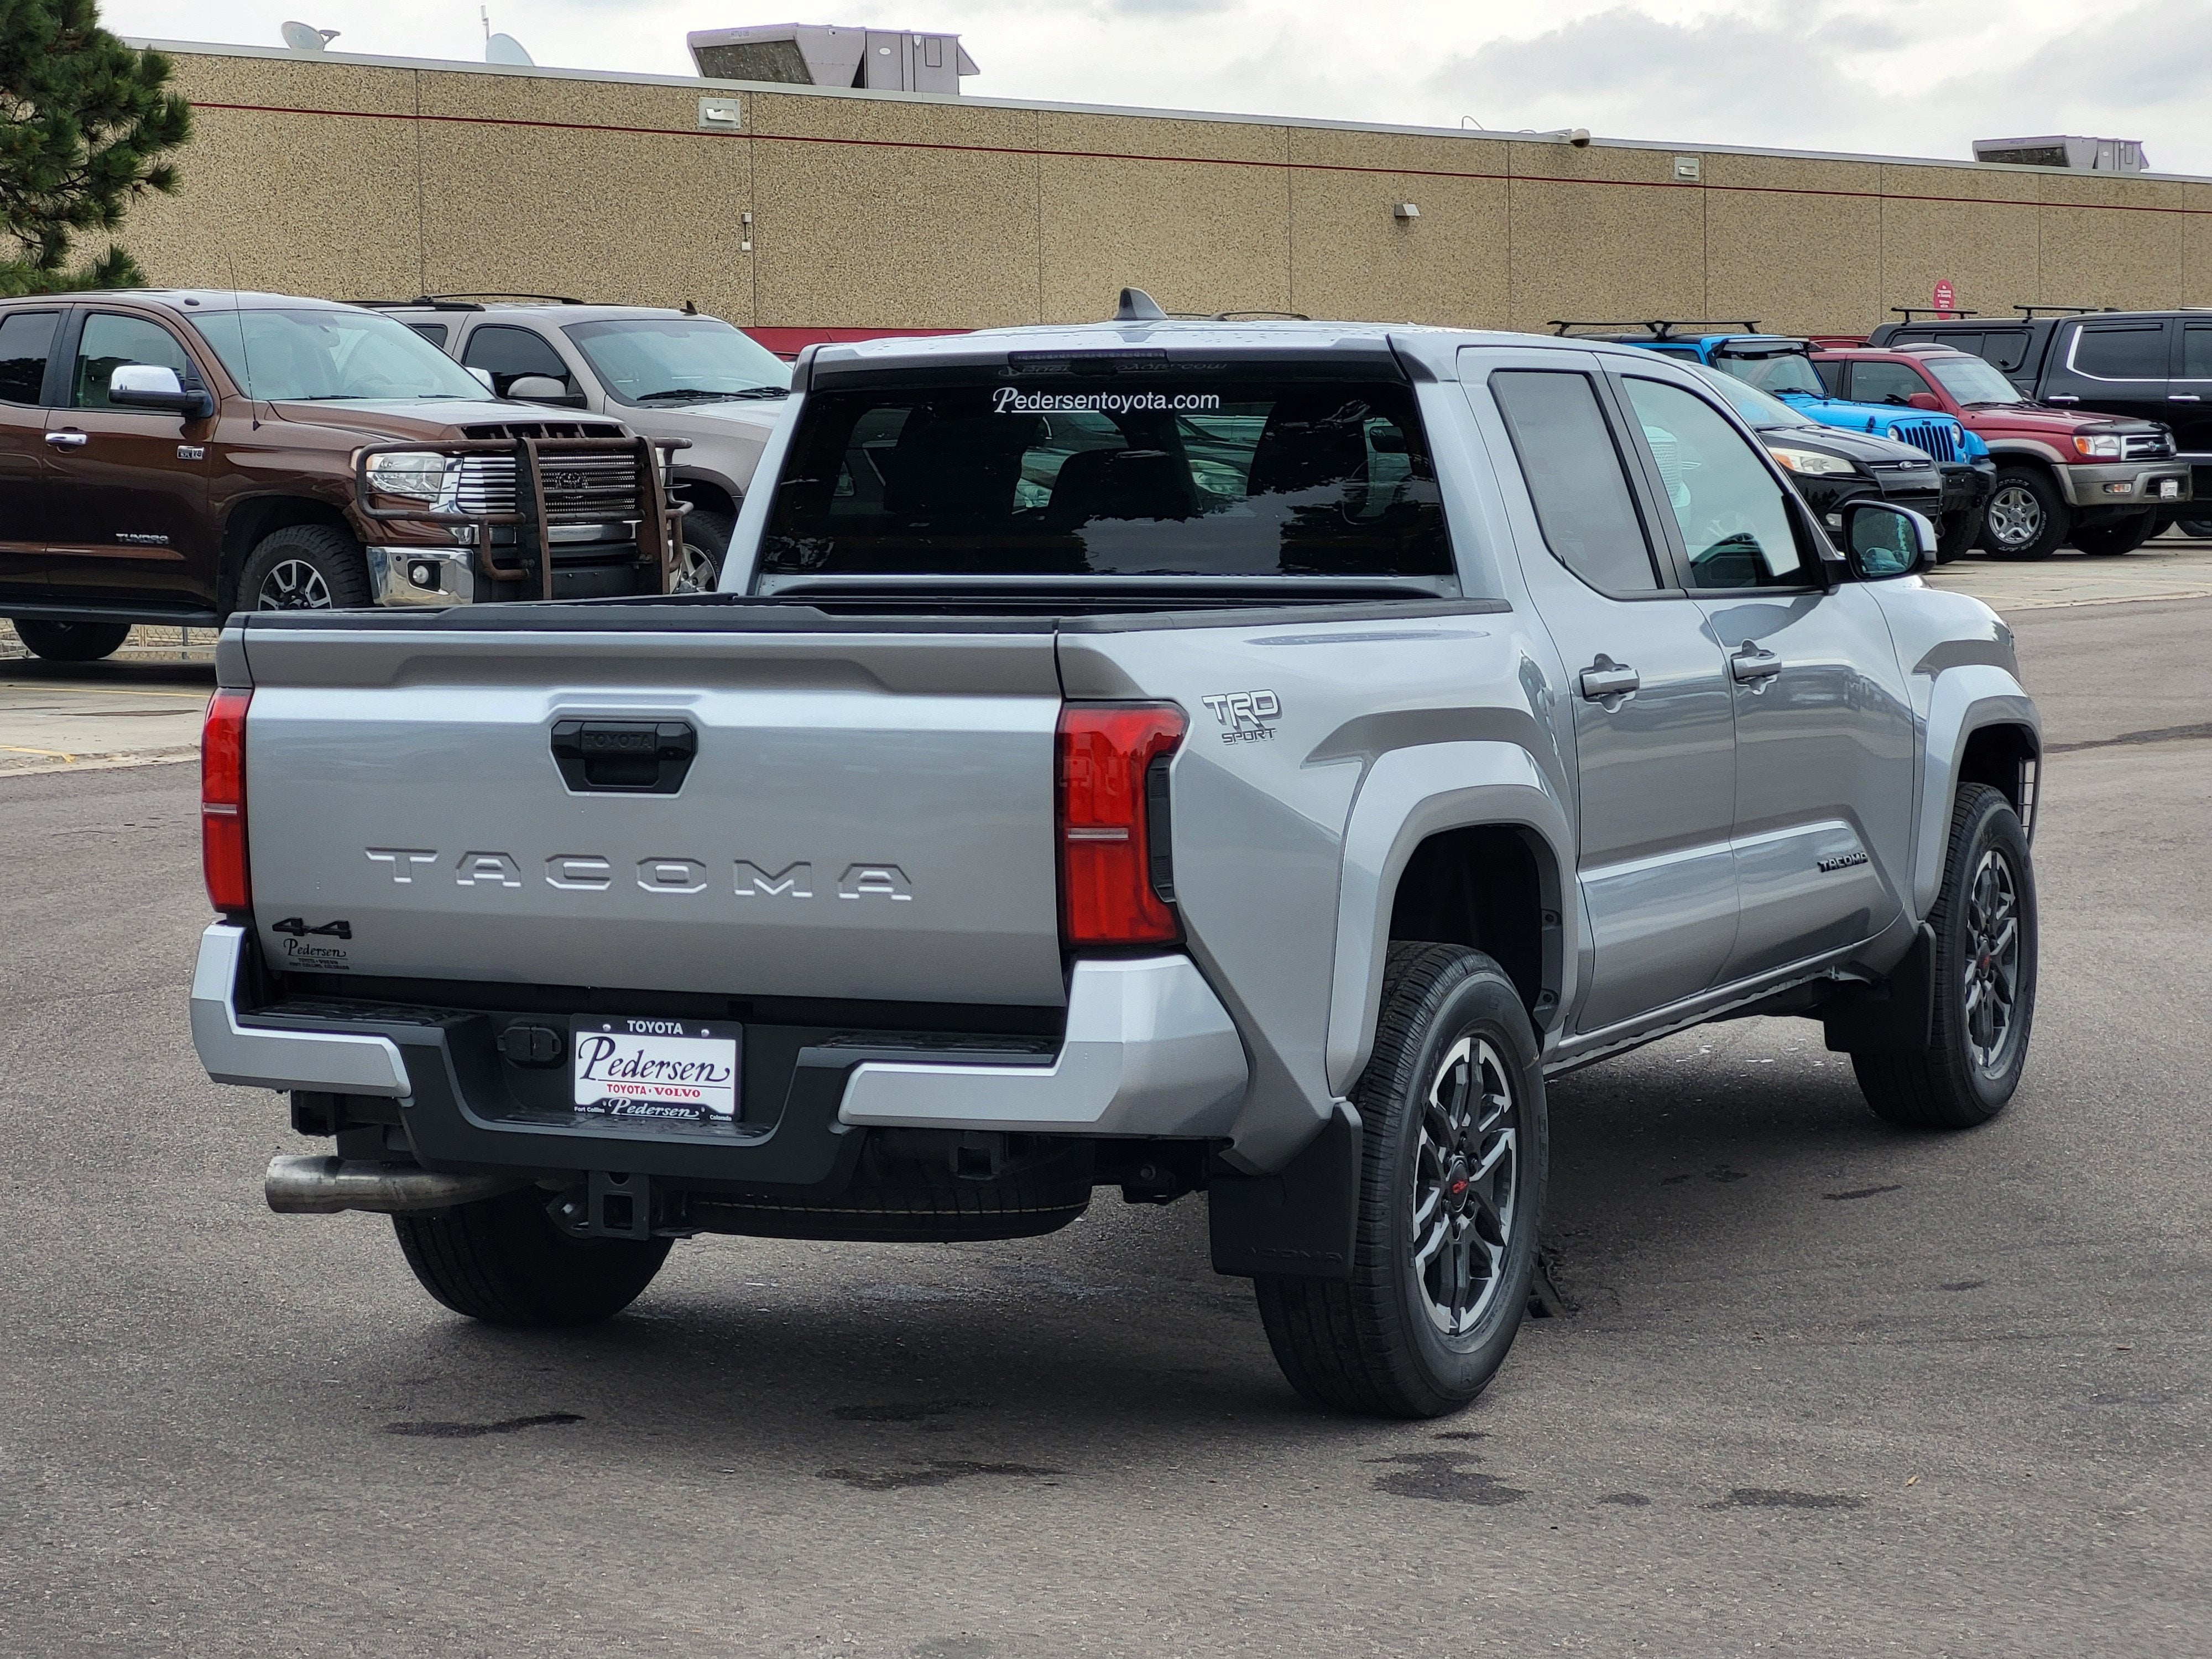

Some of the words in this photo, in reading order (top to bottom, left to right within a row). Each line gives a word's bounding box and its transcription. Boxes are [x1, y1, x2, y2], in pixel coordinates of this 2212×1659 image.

[993, 387, 1219, 414] Pedersentoyota.com
[116, 533, 169, 544] TUNDRA
[1201, 689, 1282, 732] TRD
[1222, 728, 1277, 745] SPORT
[1817, 852, 1868, 873] TACOMA
[365, 846, 912, 901] TACOMA
[283, 938, 347, 957] Pedersen
[627, 1020, 684, 1035] TOYOTA
[578, 1036, 731, 1082] Pedersen
[607, 1083, 646, 1095] TOYOTA
[654, 1087, 701, 1098] VOLVO
[608, 1097, 700, 1117] Pedersen
